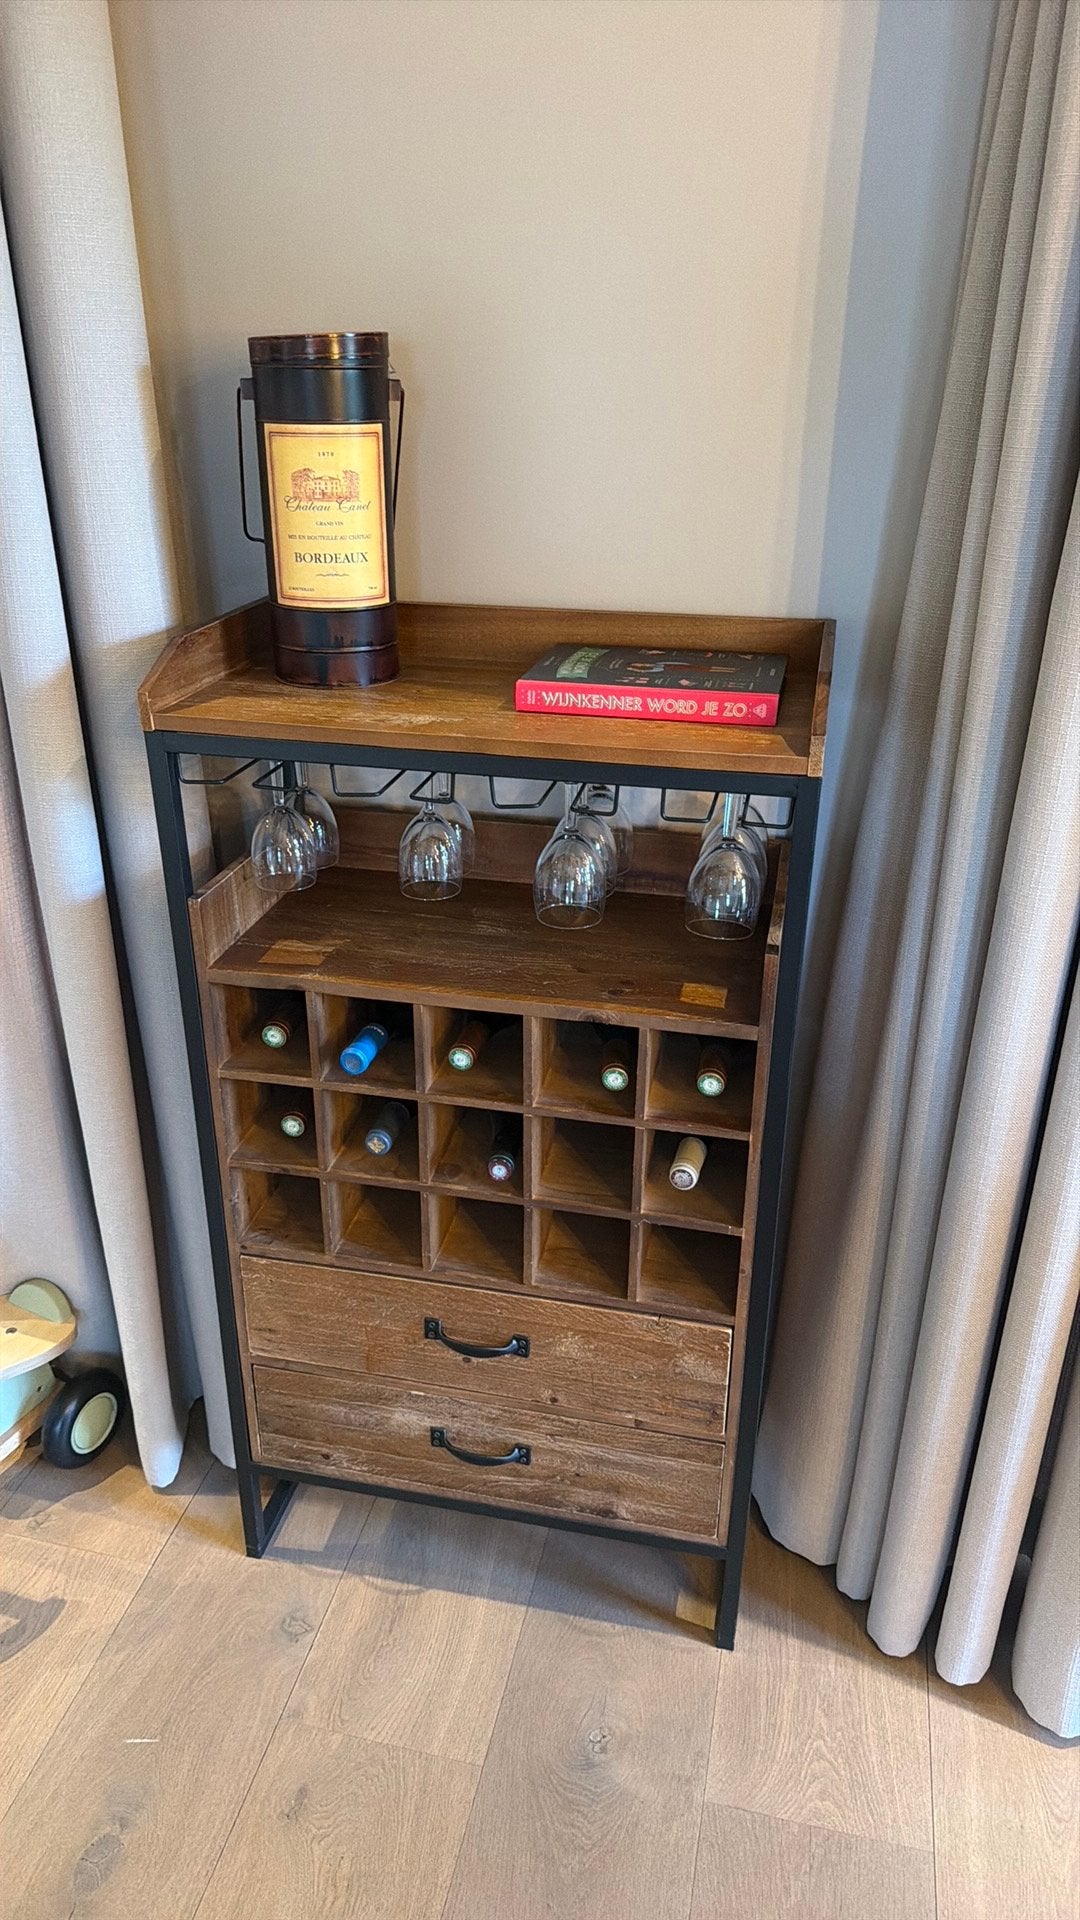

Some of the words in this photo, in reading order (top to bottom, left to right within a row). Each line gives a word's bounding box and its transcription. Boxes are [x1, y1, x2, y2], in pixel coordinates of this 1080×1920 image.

[294, 552, 369, 564] BORDEAUX
[541, 691, 642, 712] WIJNKENNER
[647, 697, 699, 715] WORD
[701, 701, 718, 716] JE
[723, 702, 748, 718] ZO
